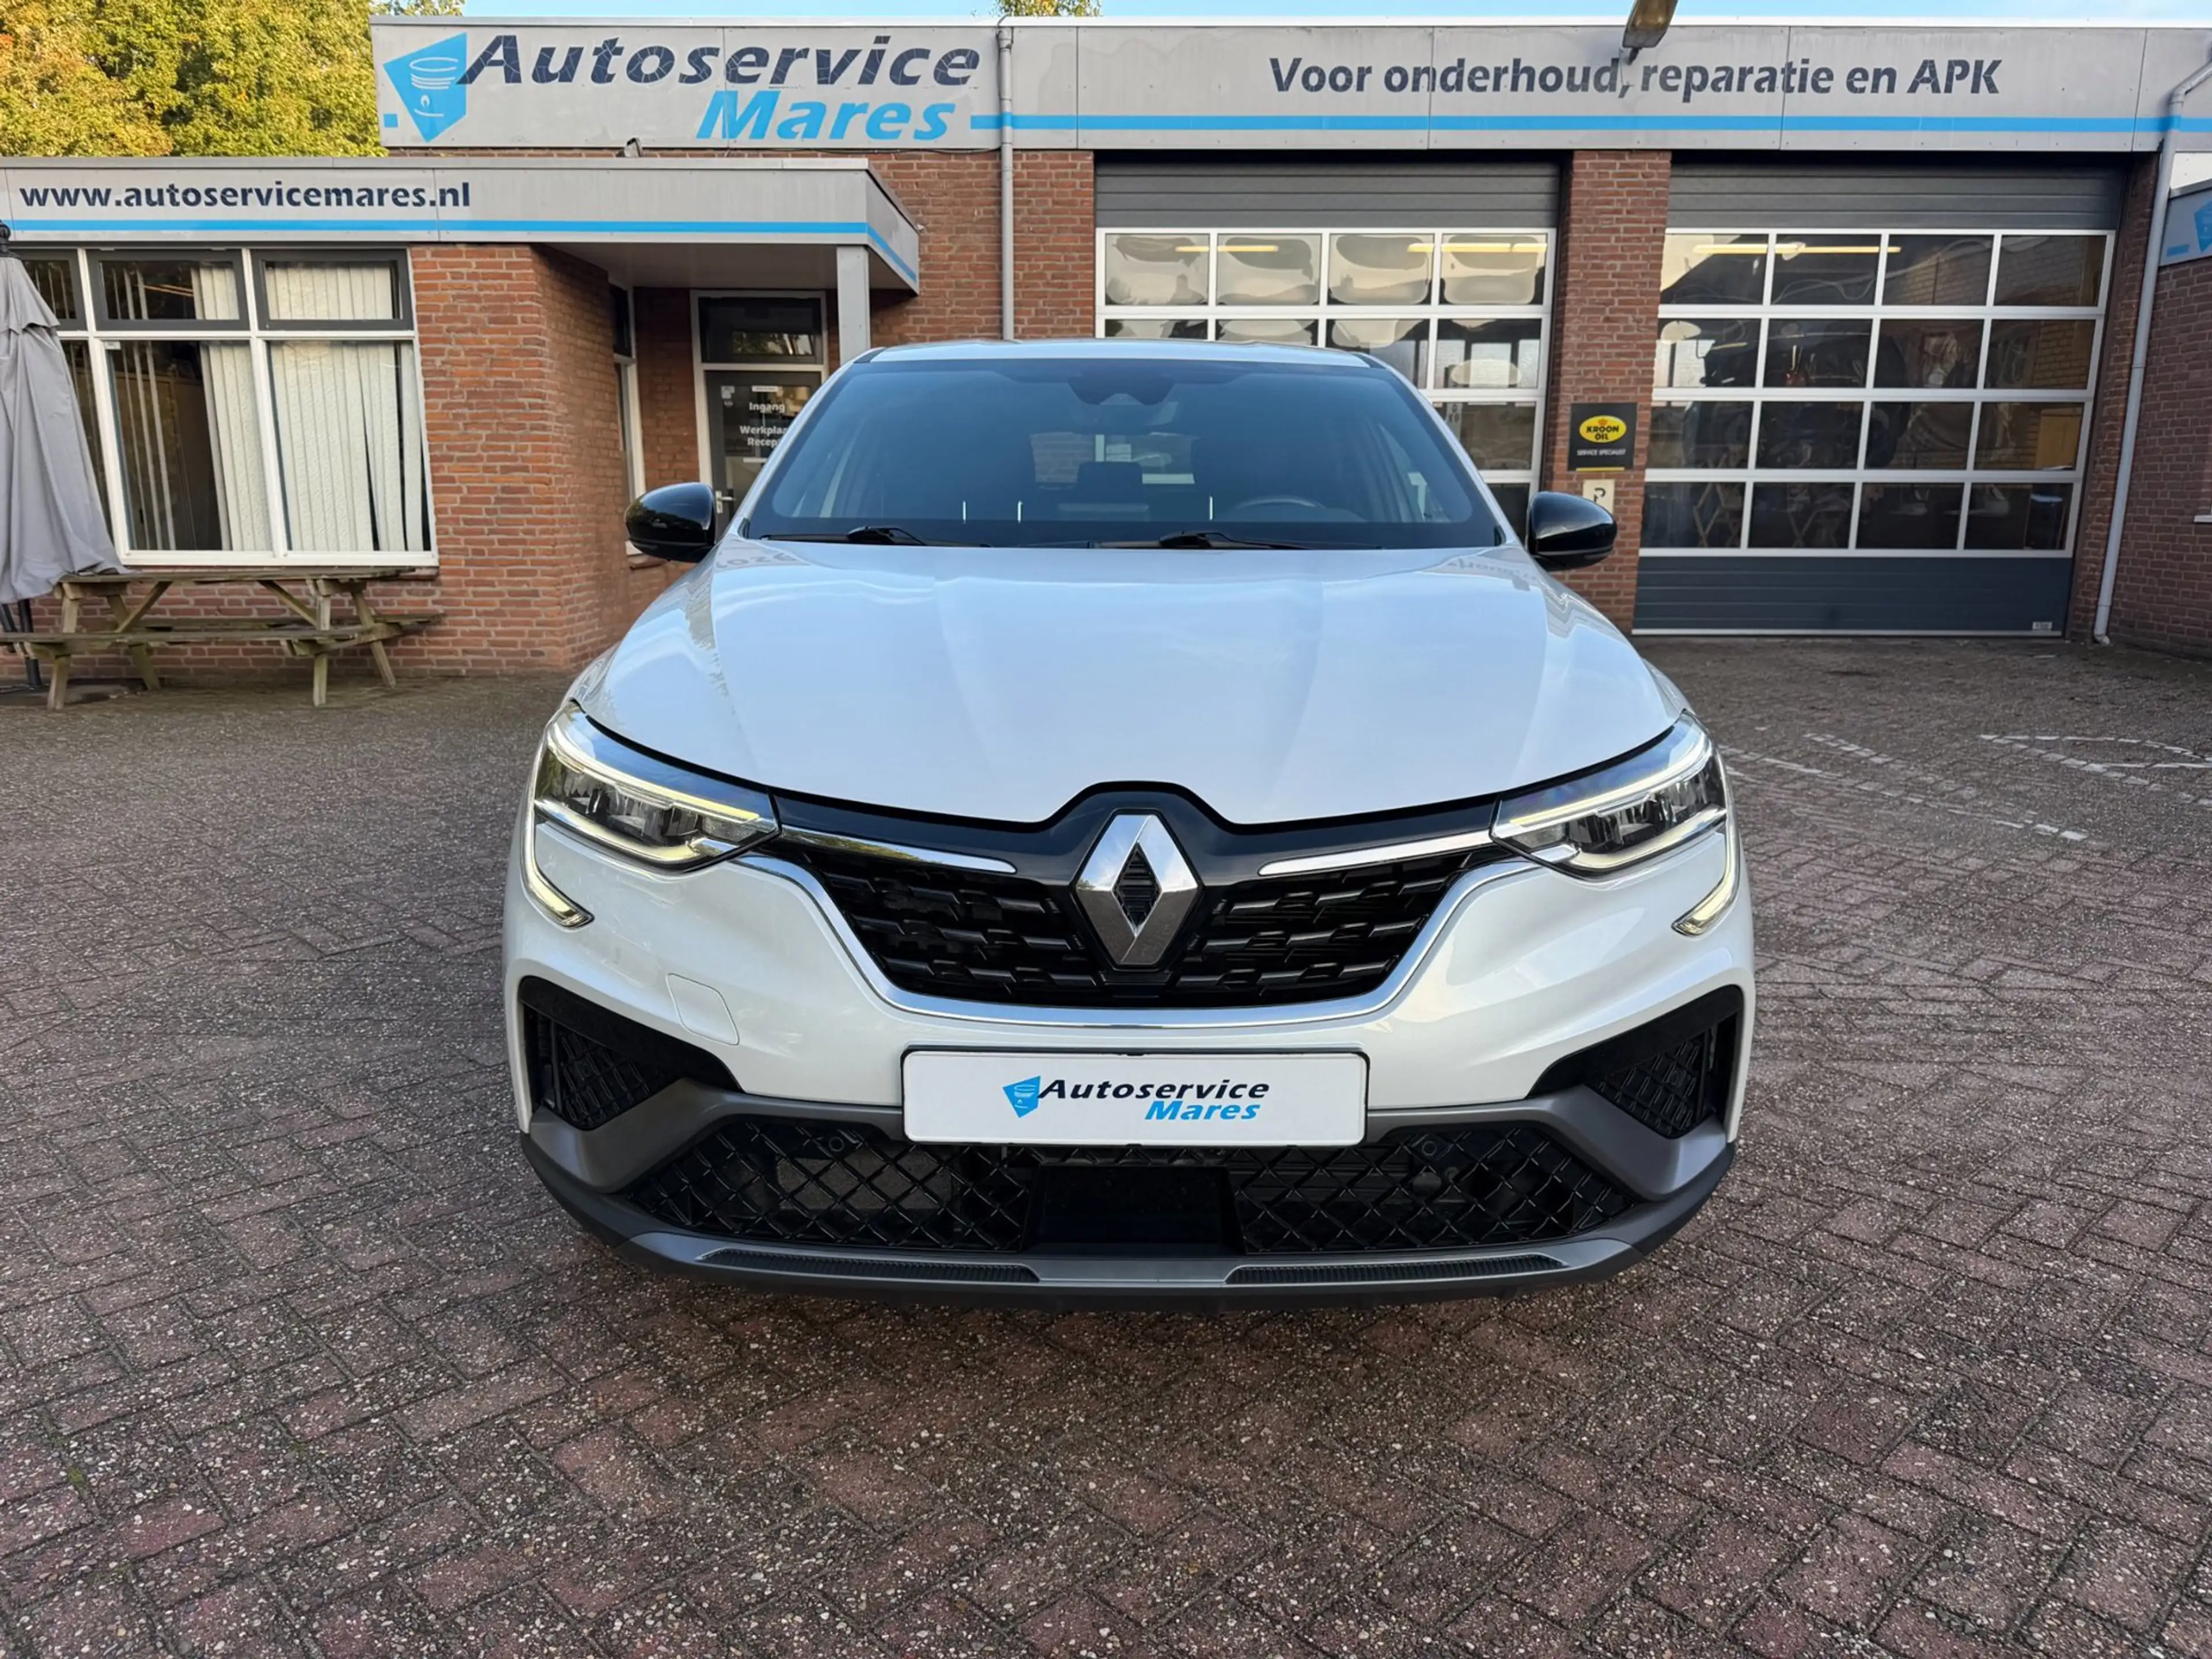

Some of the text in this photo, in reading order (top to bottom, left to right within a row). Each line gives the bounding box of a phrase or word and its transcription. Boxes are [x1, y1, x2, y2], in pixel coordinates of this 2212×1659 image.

[456, 35, 980, 86] Autoservice
[1269, 58, 2002, 103] Voor onderhoud, reparatie en APK
[695, 90, 956, 141] Mares
[19, 180, 470, 207] www.autoservicemares.nl
[749, 402, 786, 414] Ingang
[739, 425, 787, 437] Werkplaa
[1586, 425, 1619, 433] KROON
[747, 437, 778, 448] Recep
[1037, 1079, 1270, 1099] Autoservice
[1144, 1100, 1261, 1120] Mares
